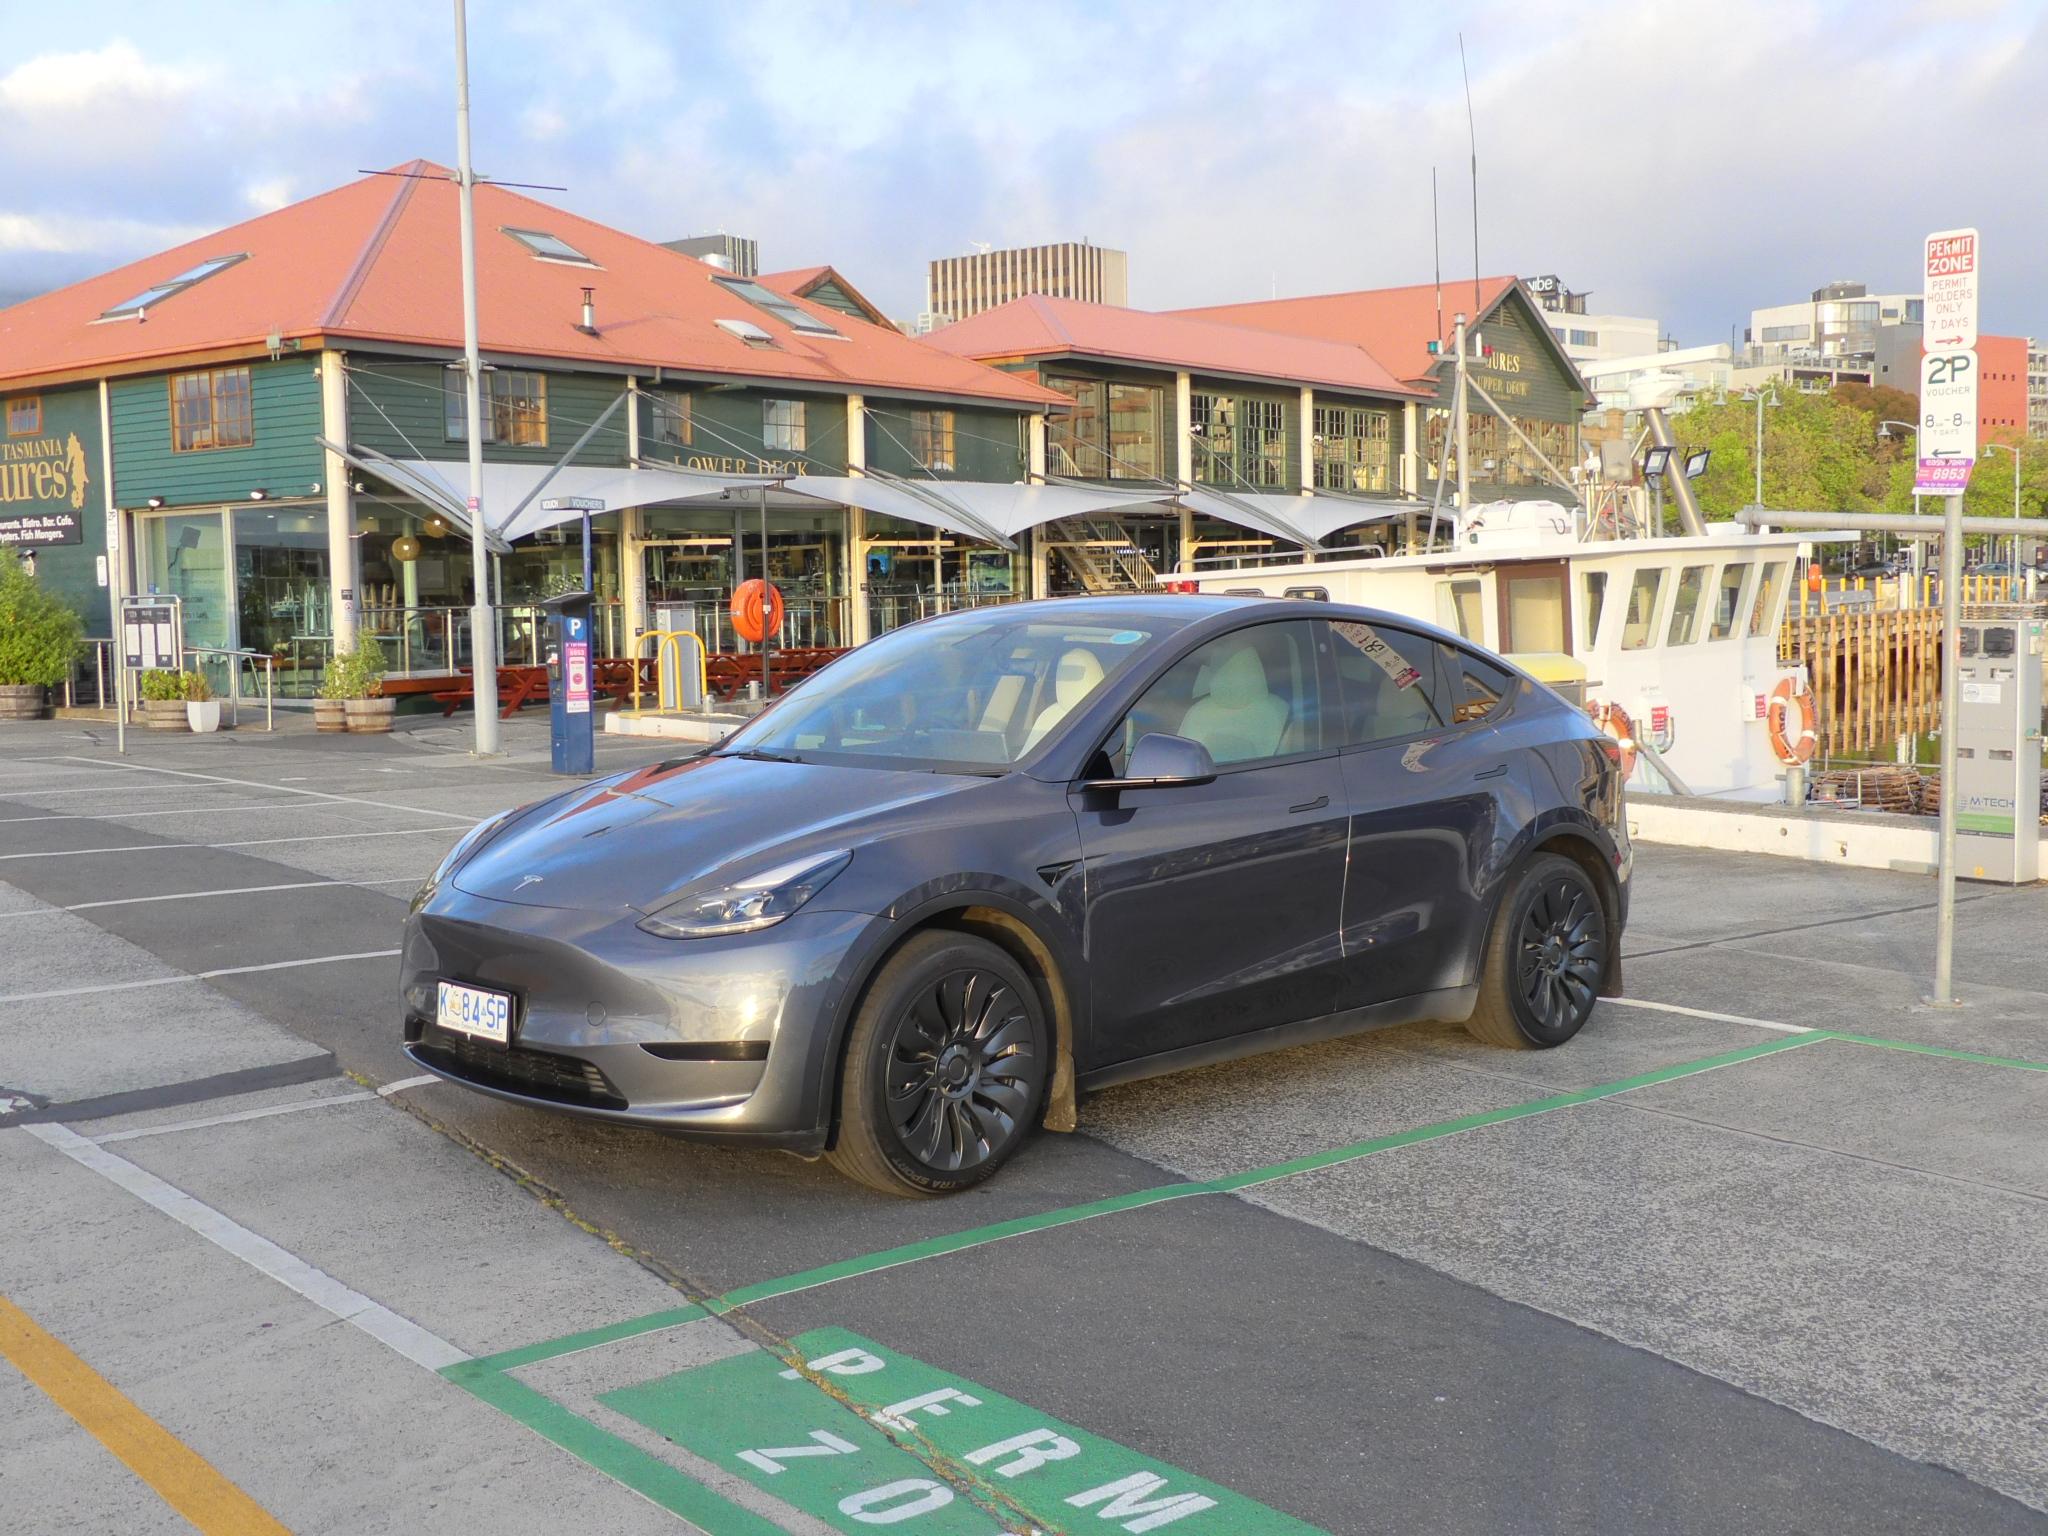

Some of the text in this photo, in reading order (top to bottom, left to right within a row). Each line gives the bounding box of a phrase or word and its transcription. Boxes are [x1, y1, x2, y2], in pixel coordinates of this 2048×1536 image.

[1929, 237, 1972, 257] PERMIT
[1928, 255, 1972, 275] ZONE
[1527, 275, 1553, 291] vibe
[1932, 277, 1968, 290] PERMIT
[1927, 289, 1973, 303] HOLDERS
[1936, 302, 1963, 314] ONLY
[1930, 317, 1969, 330] 7 DAYS
[1484, 352, 1520, 373] URES
[1928, 355, 1970, 384] 2P
[1926, 386, 1970, 397] VOUCHER
[2, 439, 63, 460] TASMANIA
[674, 455, 809, 477] LOWER DECK
[1933, 468, 1966, 480] 6953
[0, 460, 67, 503] ures
[0, 532, 20, 543] ysters.
[570, 619, 581, 636] P
[735, 1429, 956, 1526] ZO
